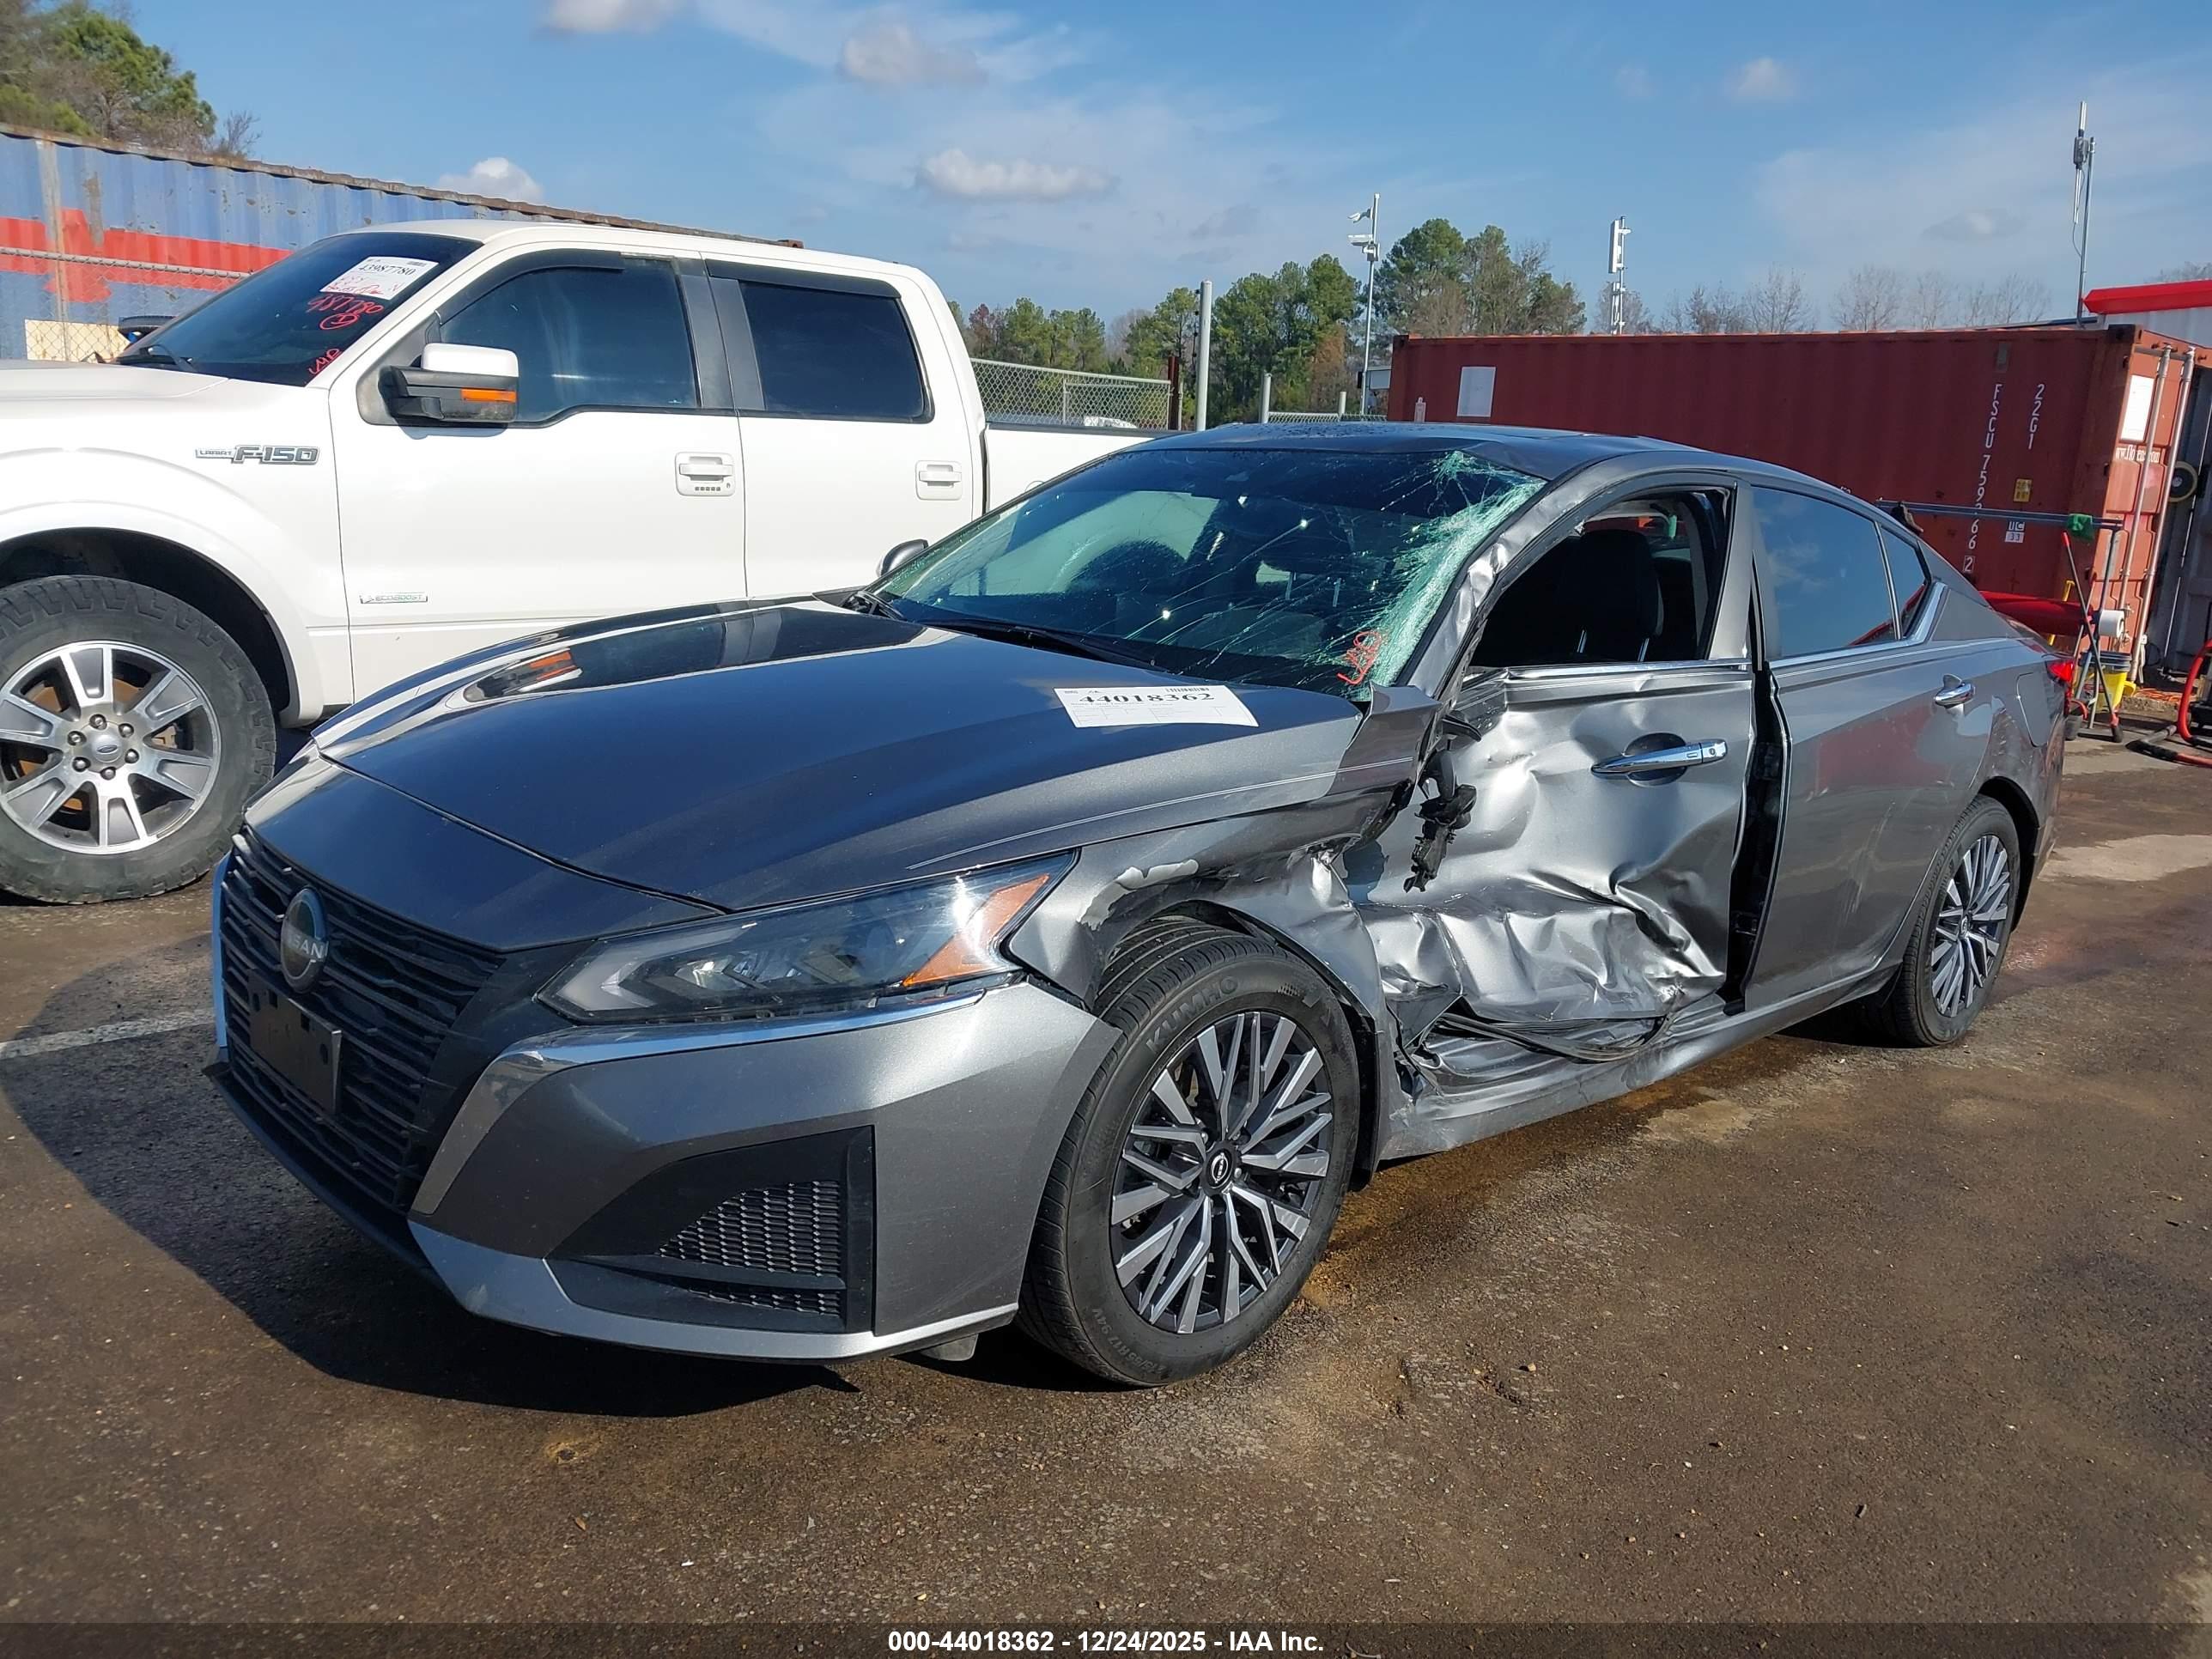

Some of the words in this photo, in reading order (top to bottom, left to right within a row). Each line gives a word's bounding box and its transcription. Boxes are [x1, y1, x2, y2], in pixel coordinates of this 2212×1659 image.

[358, 264, 417, 276] 43987780
[1984, 383, 2003, 449] FSCU
[234, 445, 319, 464] F-150
[1963, 556, 1975, 573] 2
[1079, 693, 1215, 703] 44018362
